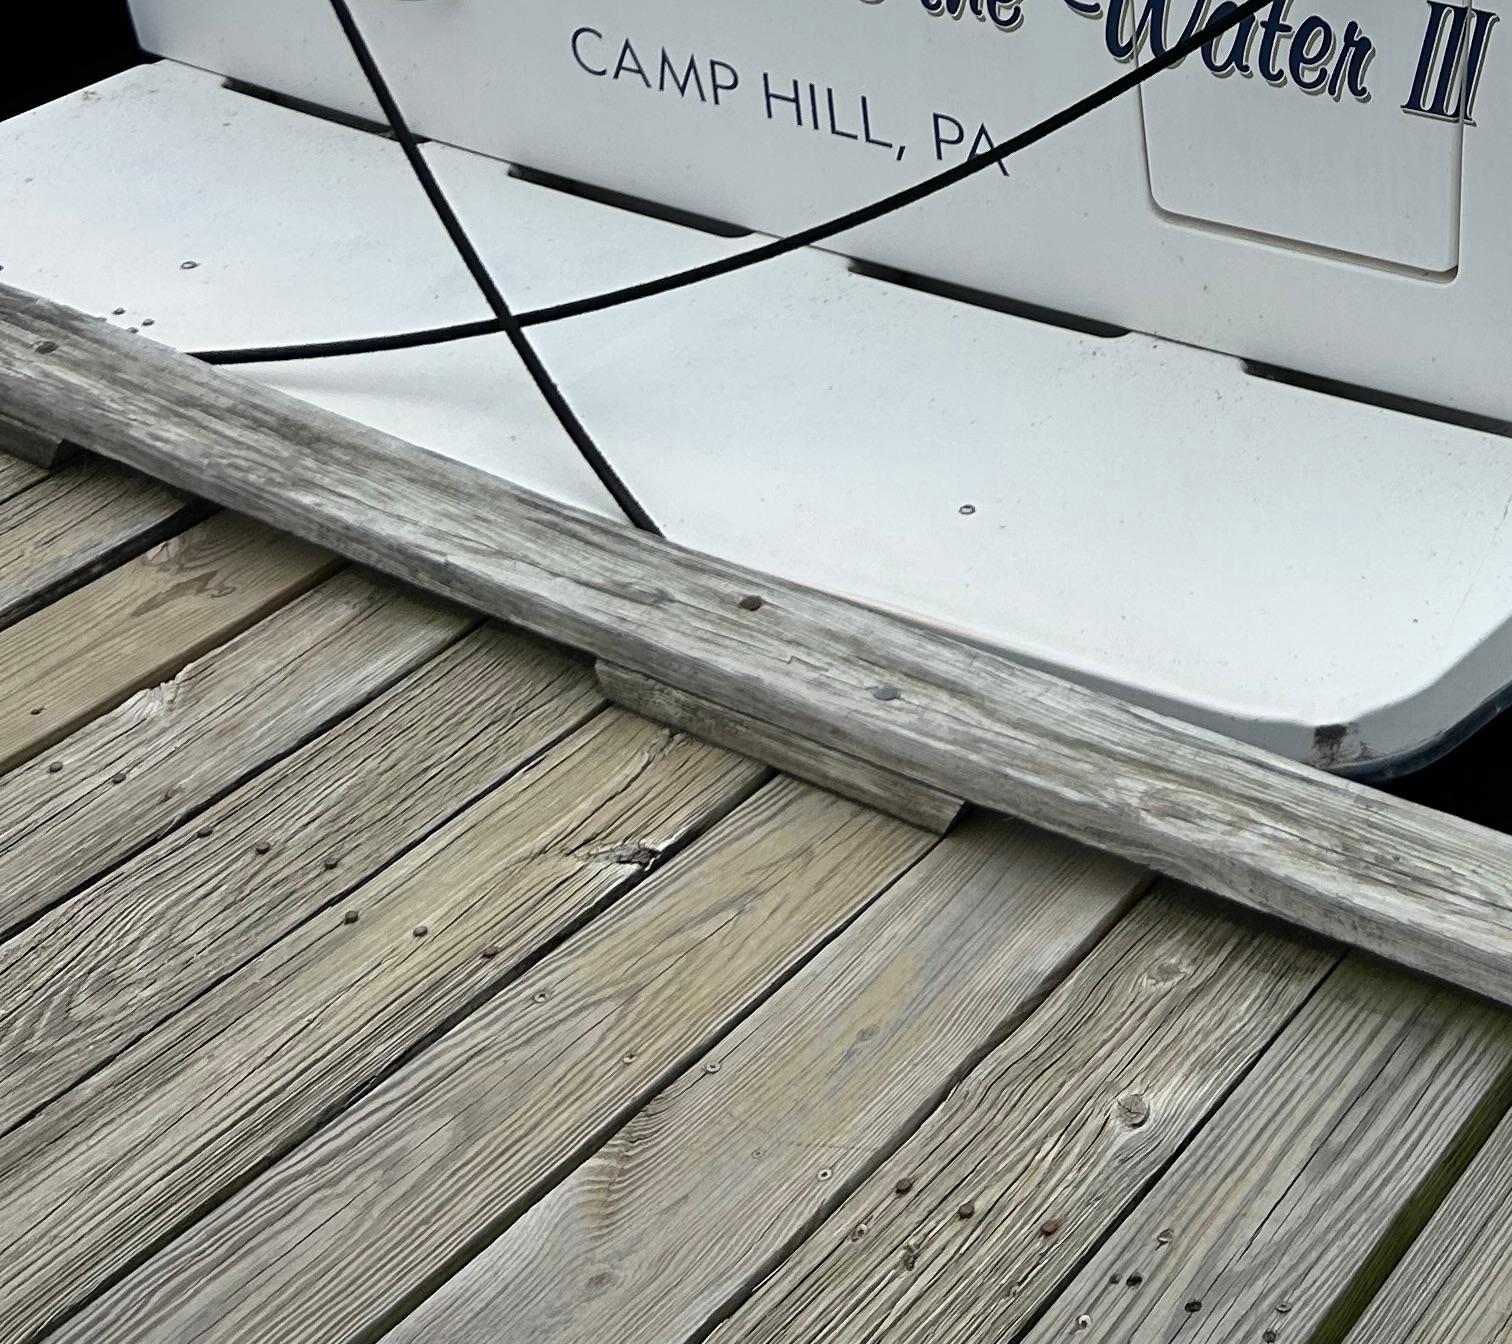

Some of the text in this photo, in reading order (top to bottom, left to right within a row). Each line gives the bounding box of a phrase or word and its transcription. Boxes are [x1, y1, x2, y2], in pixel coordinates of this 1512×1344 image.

[571, 26, 1010, 177] CAMP HILL, PA
[1399, 0, 1500, 126] III
